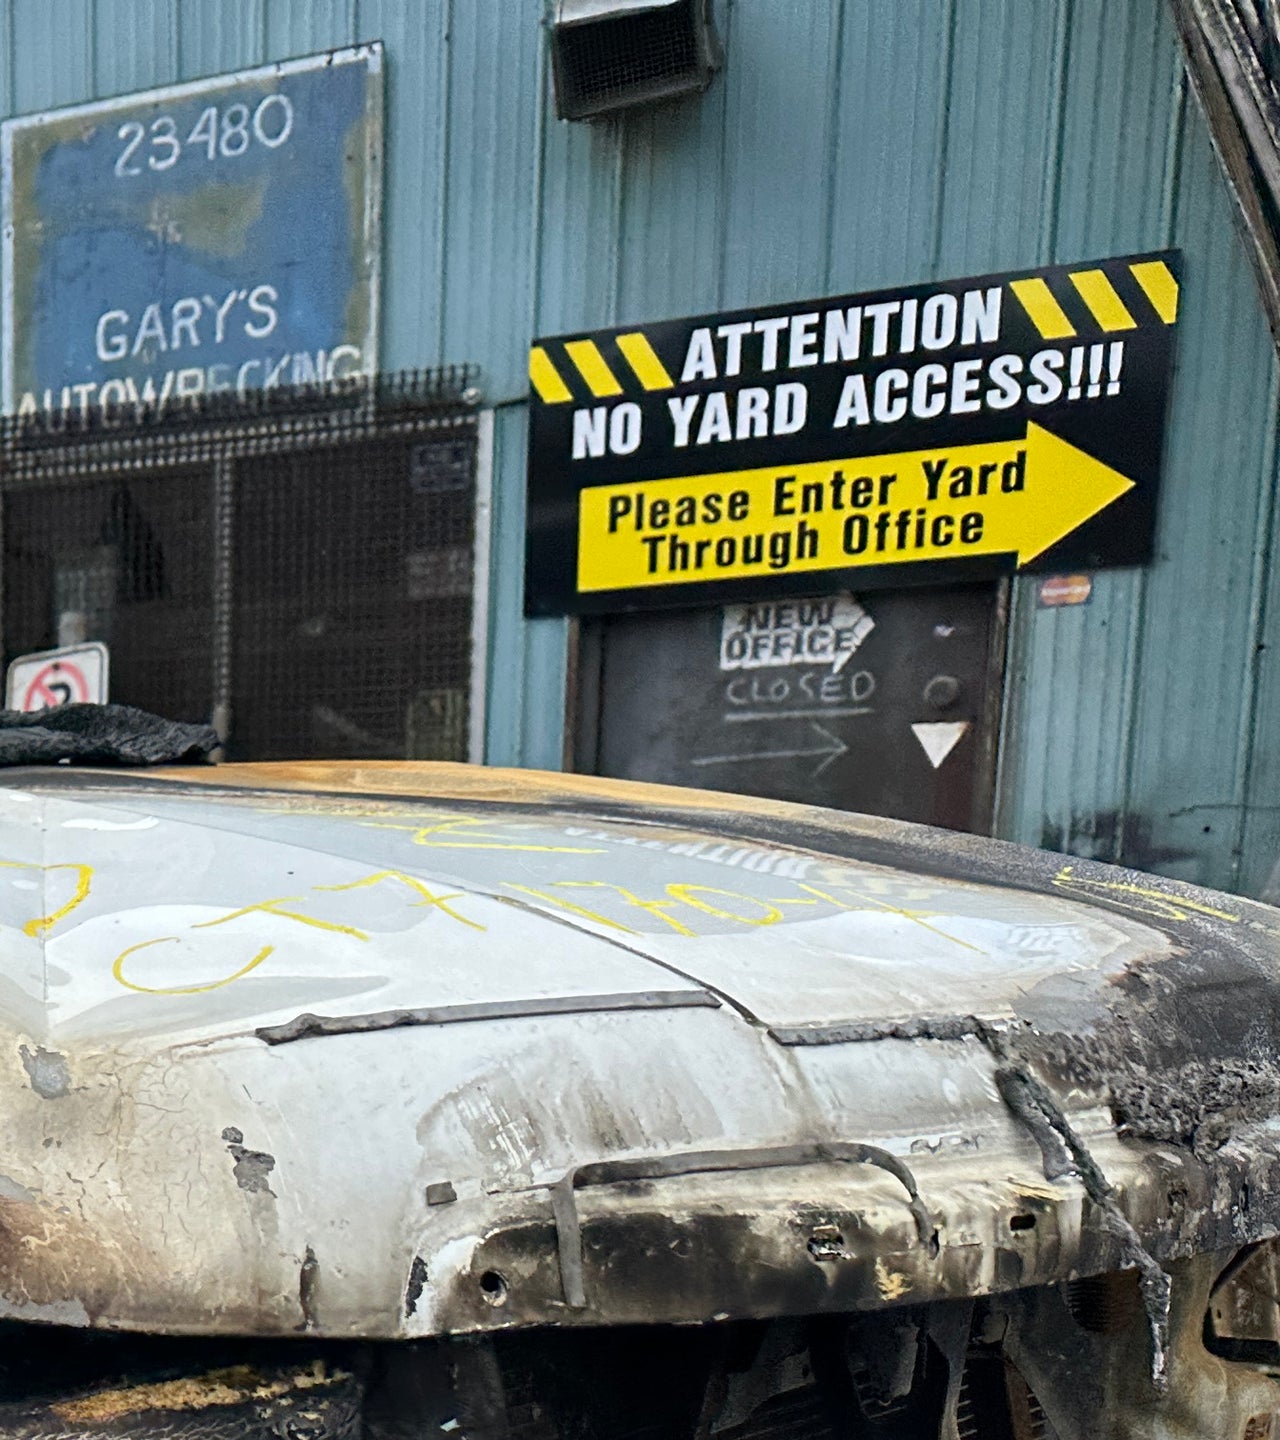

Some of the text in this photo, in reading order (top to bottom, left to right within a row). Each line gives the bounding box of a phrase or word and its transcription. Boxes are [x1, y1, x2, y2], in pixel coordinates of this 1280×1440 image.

[113, 93, 294, 178] 23480
[95, 284, 279, 362] GARY'S
[680, 286, 1003, 383] ATTENTION
[572, 341, 1125, 460] NO YARD ACCESS!!!
[607, 450, 1028, 534] Please Enter Yard
[641, 508, 984, 575] Through Office
[724, 627, 860, 661] OFFICE
[743, 601, 833, 630] NEW
[726, 670, 876, 705] CLOSED
